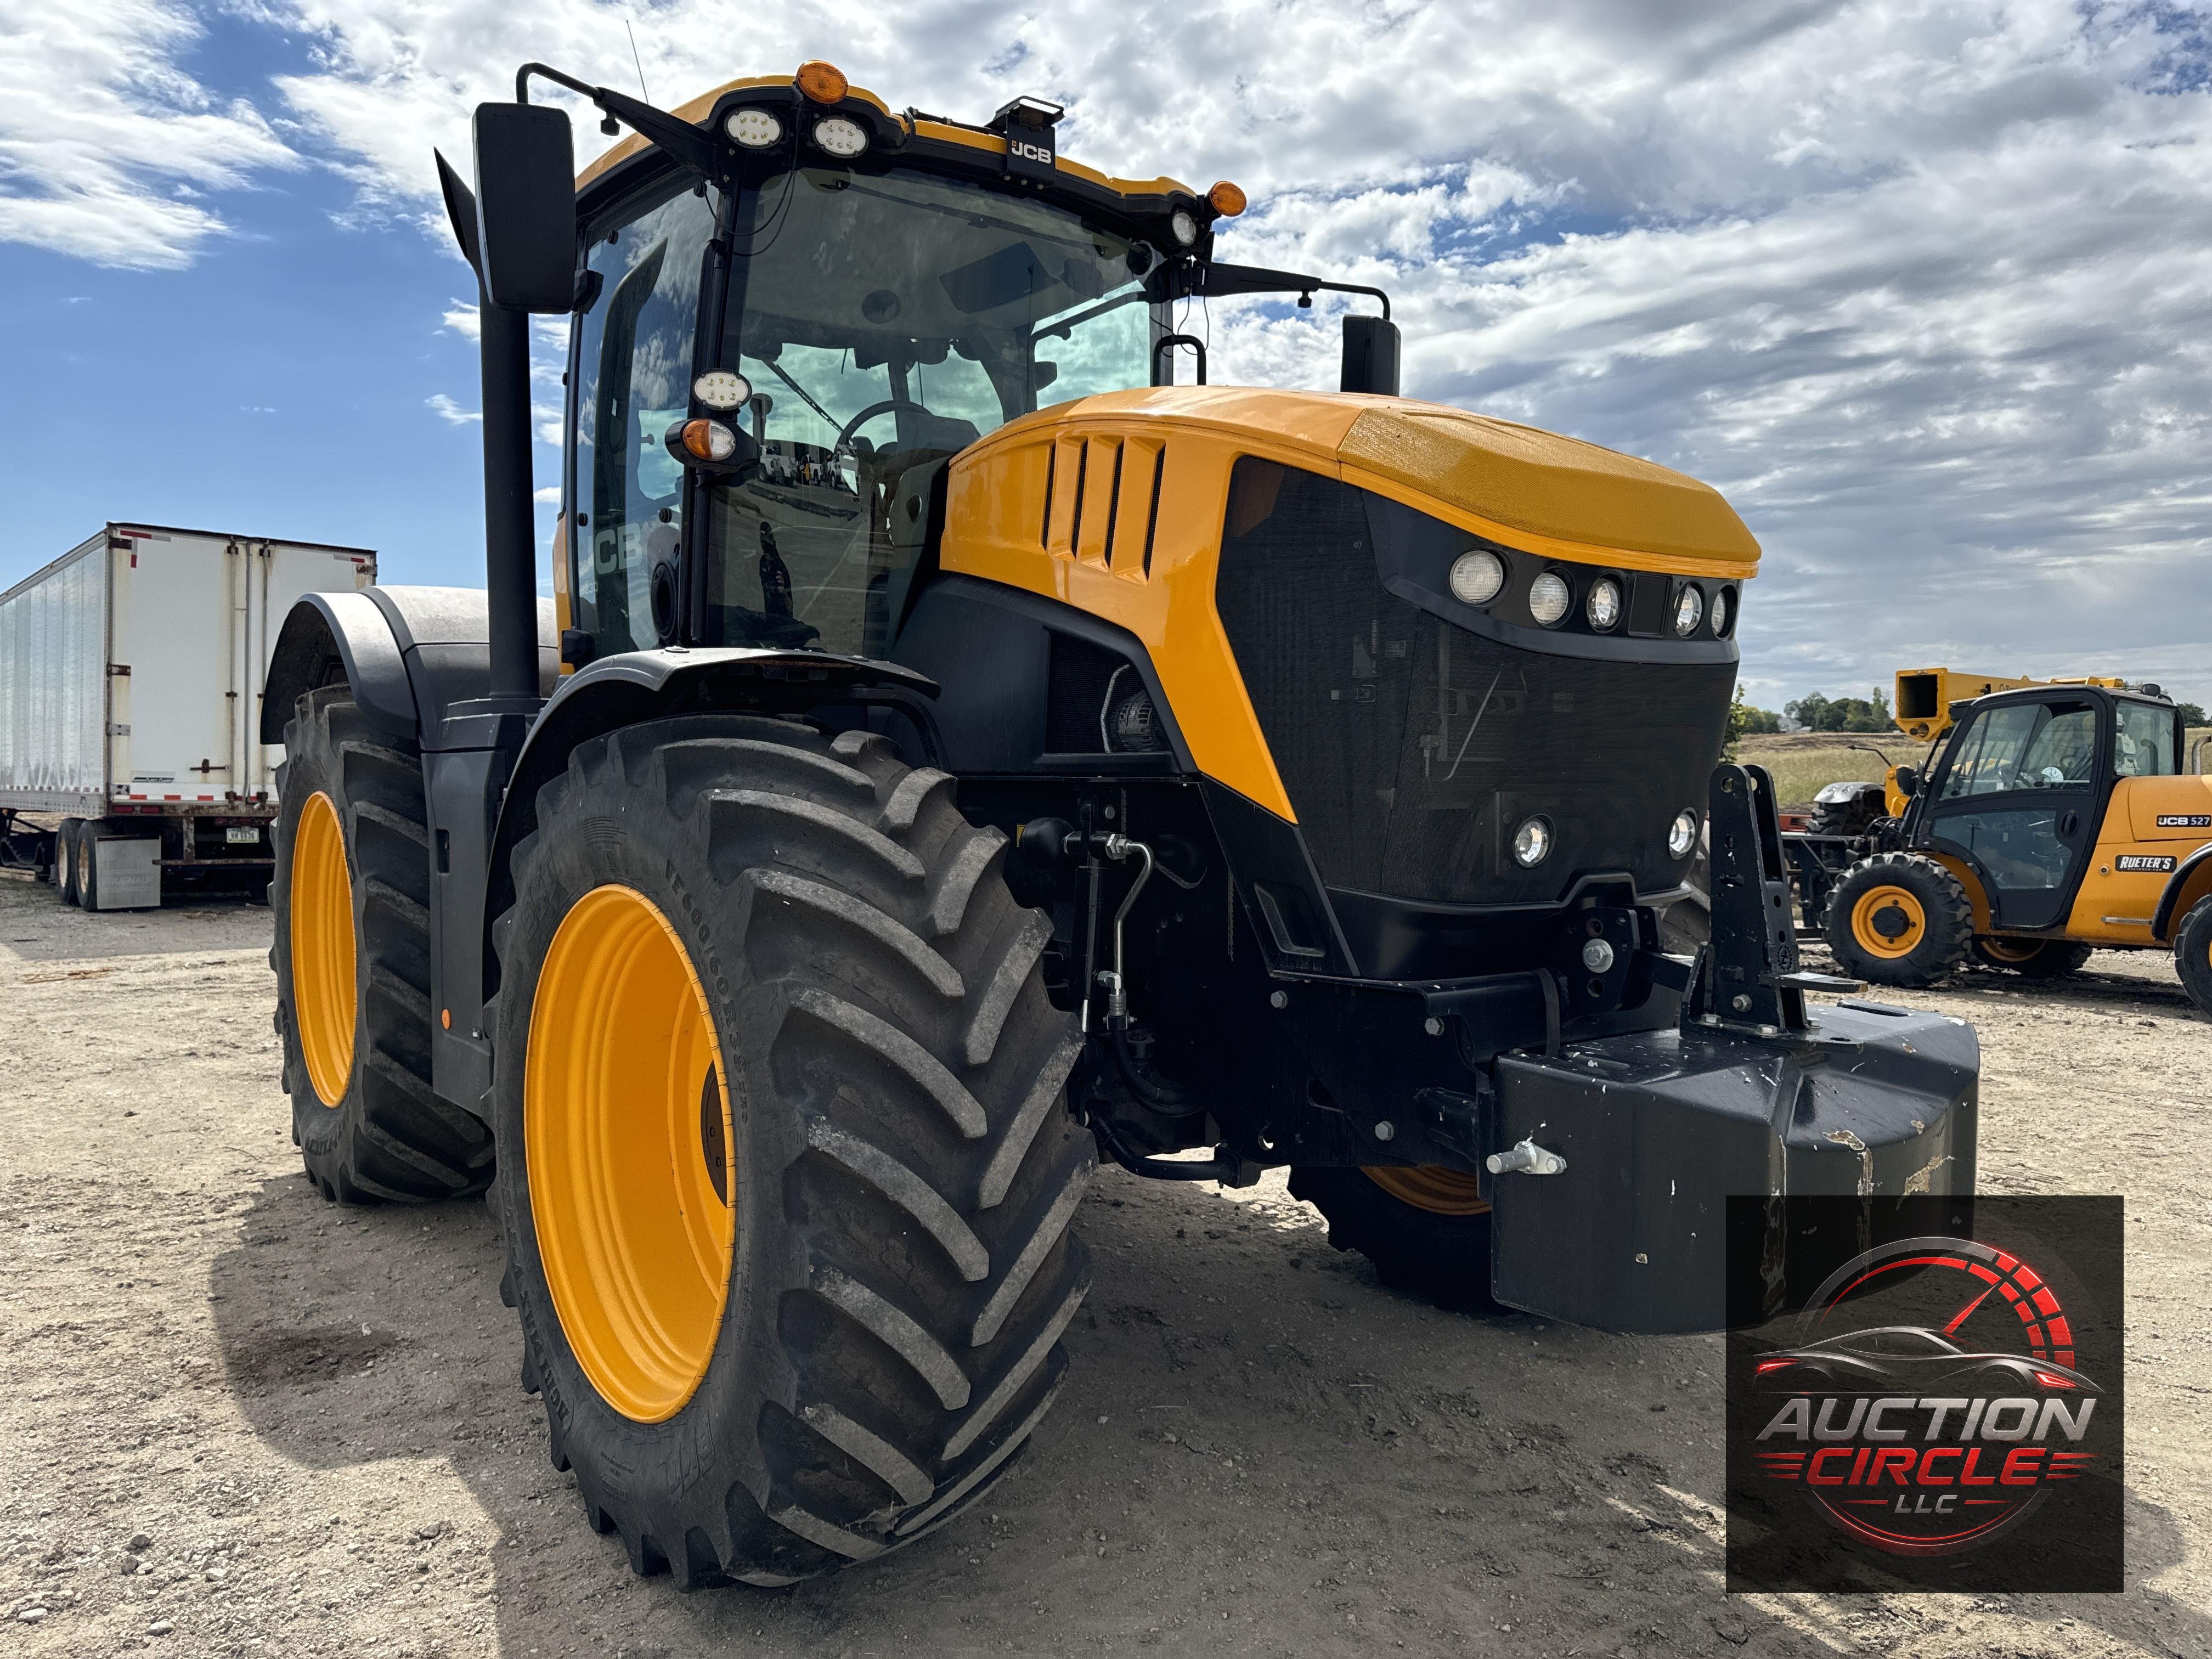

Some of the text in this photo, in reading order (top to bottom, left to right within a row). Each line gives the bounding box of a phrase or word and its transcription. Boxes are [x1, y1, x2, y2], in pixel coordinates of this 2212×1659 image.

[1012, 140, 1052, 164] JCB
[2158, 817, 2210, 825] JCB 527
[2120, 856, 2172, 870] RUETER'S
[519, 1288, 569, 1423] AGRIMAX
